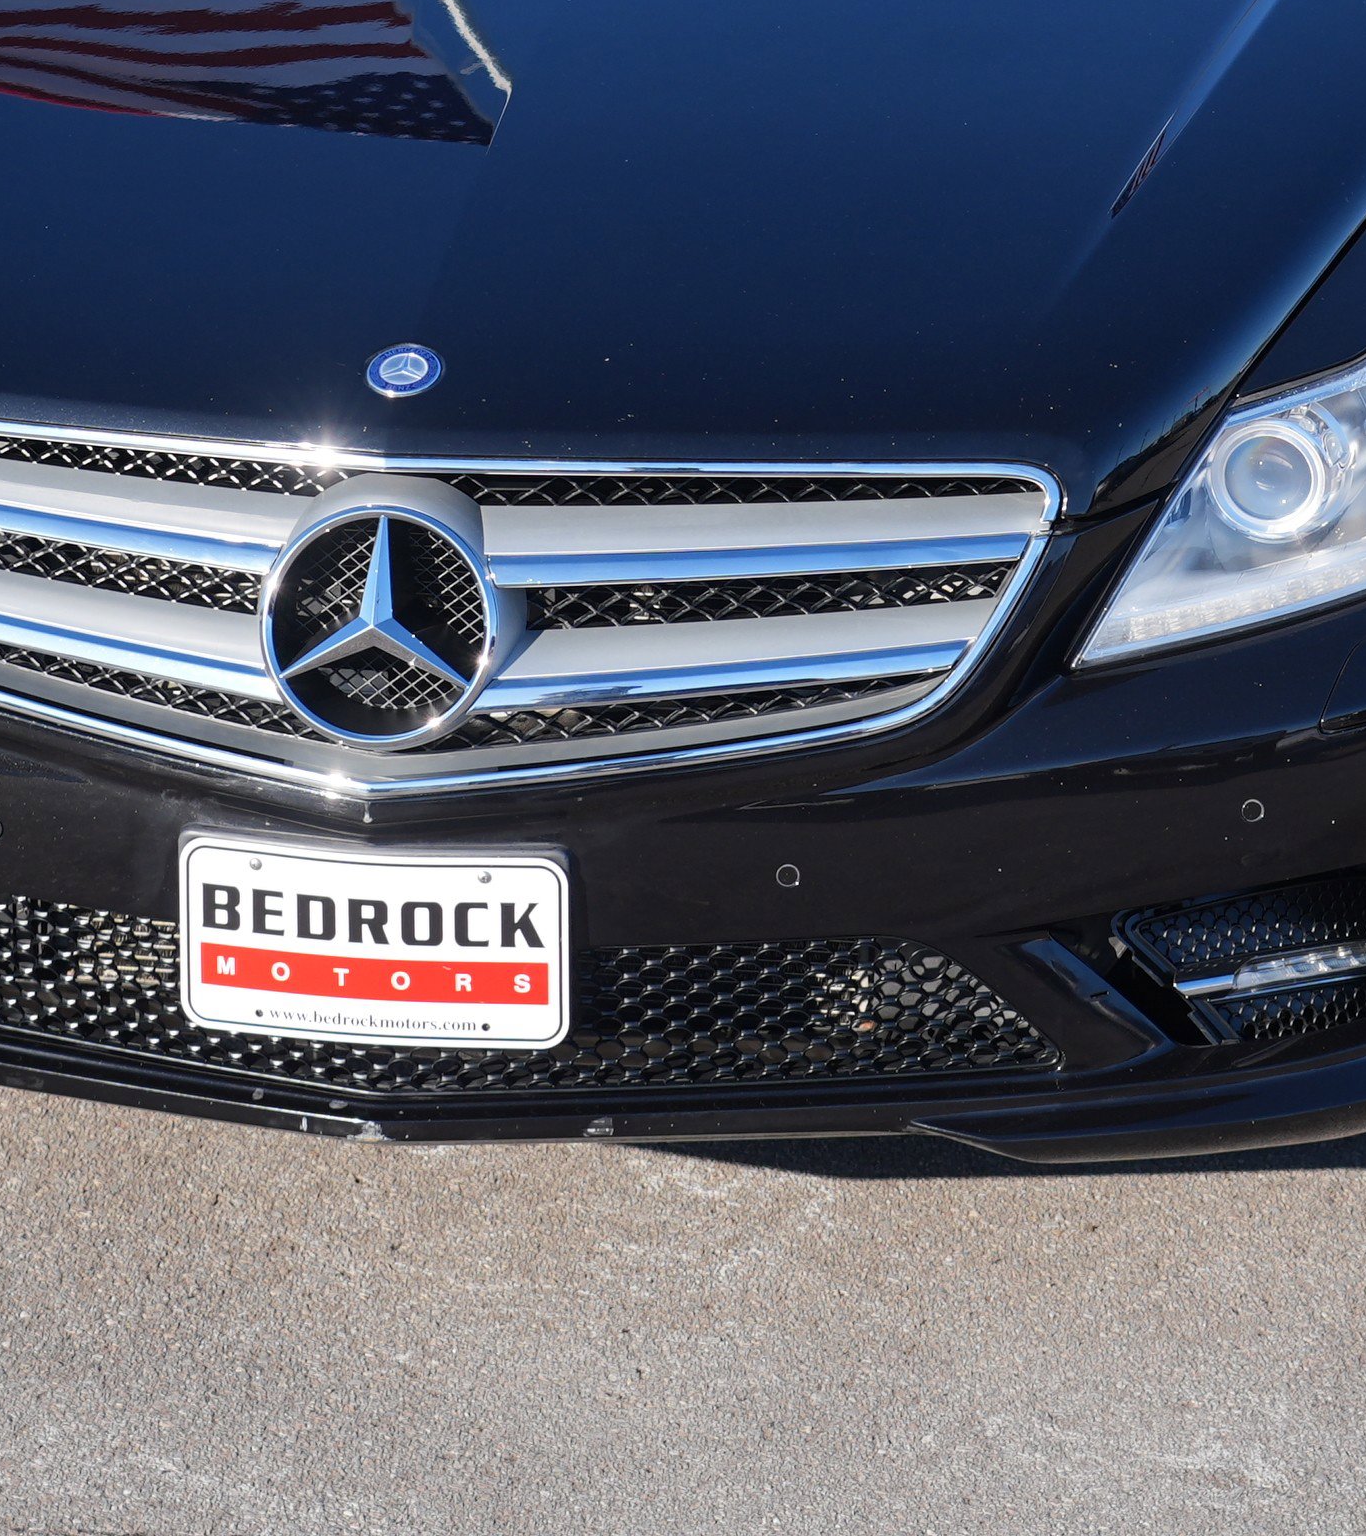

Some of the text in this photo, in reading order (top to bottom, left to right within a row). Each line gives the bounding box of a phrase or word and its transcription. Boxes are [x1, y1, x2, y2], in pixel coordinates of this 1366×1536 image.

[201, 882, 545, 949] BEDROCK
[216, 955, 531, 994] MOTORS
[269, 1007, 477, 1032] www.bedrockmotors.com
